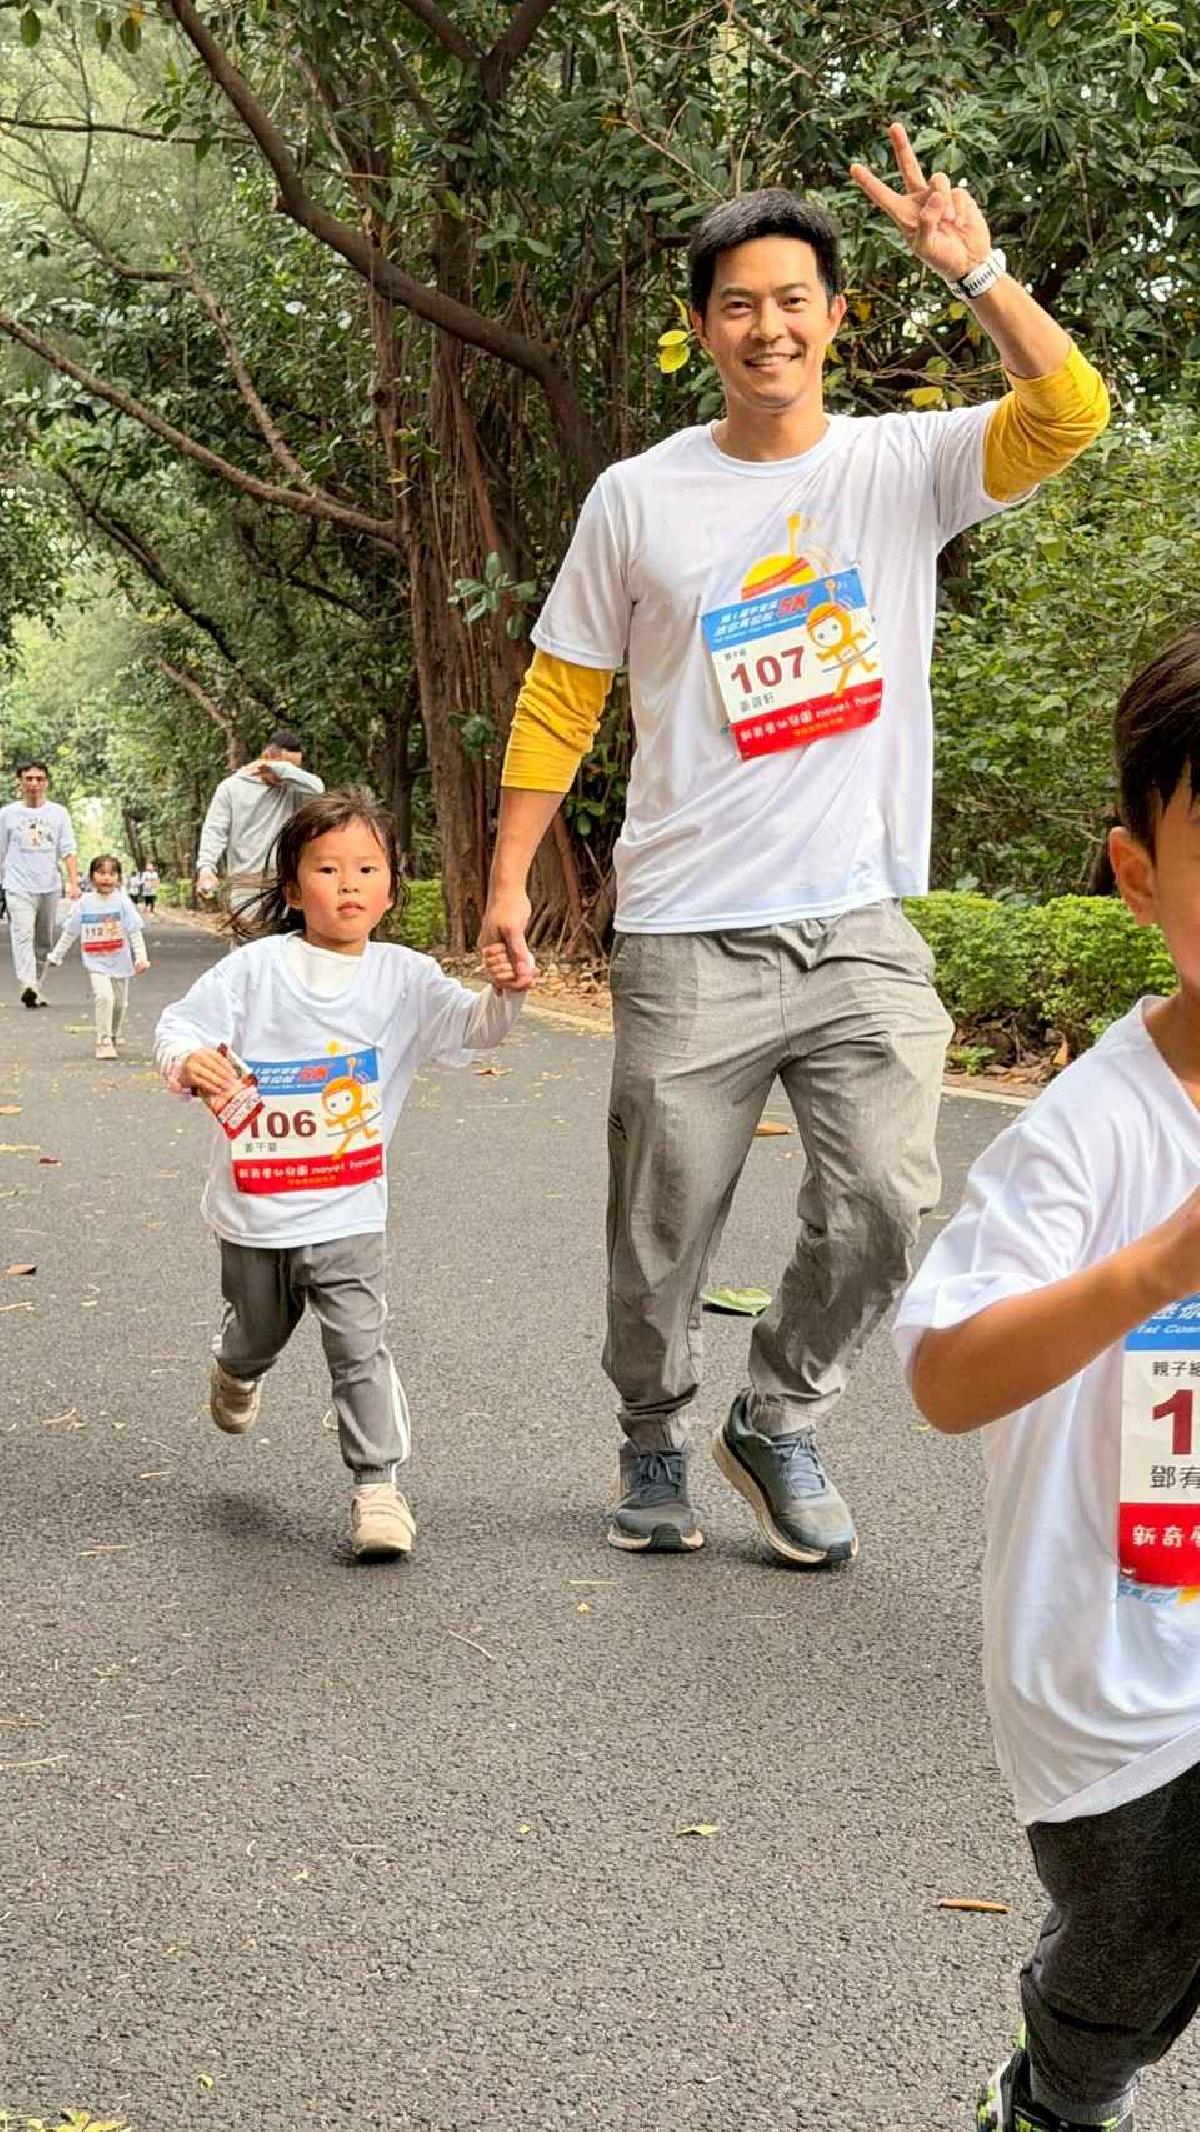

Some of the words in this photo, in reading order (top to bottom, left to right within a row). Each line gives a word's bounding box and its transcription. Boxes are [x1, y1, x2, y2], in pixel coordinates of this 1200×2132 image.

[731, 646, 803, 693] 107
[249, 1110, 317, 1138] 106
[1152, 1389, 1194, 1455] 1
